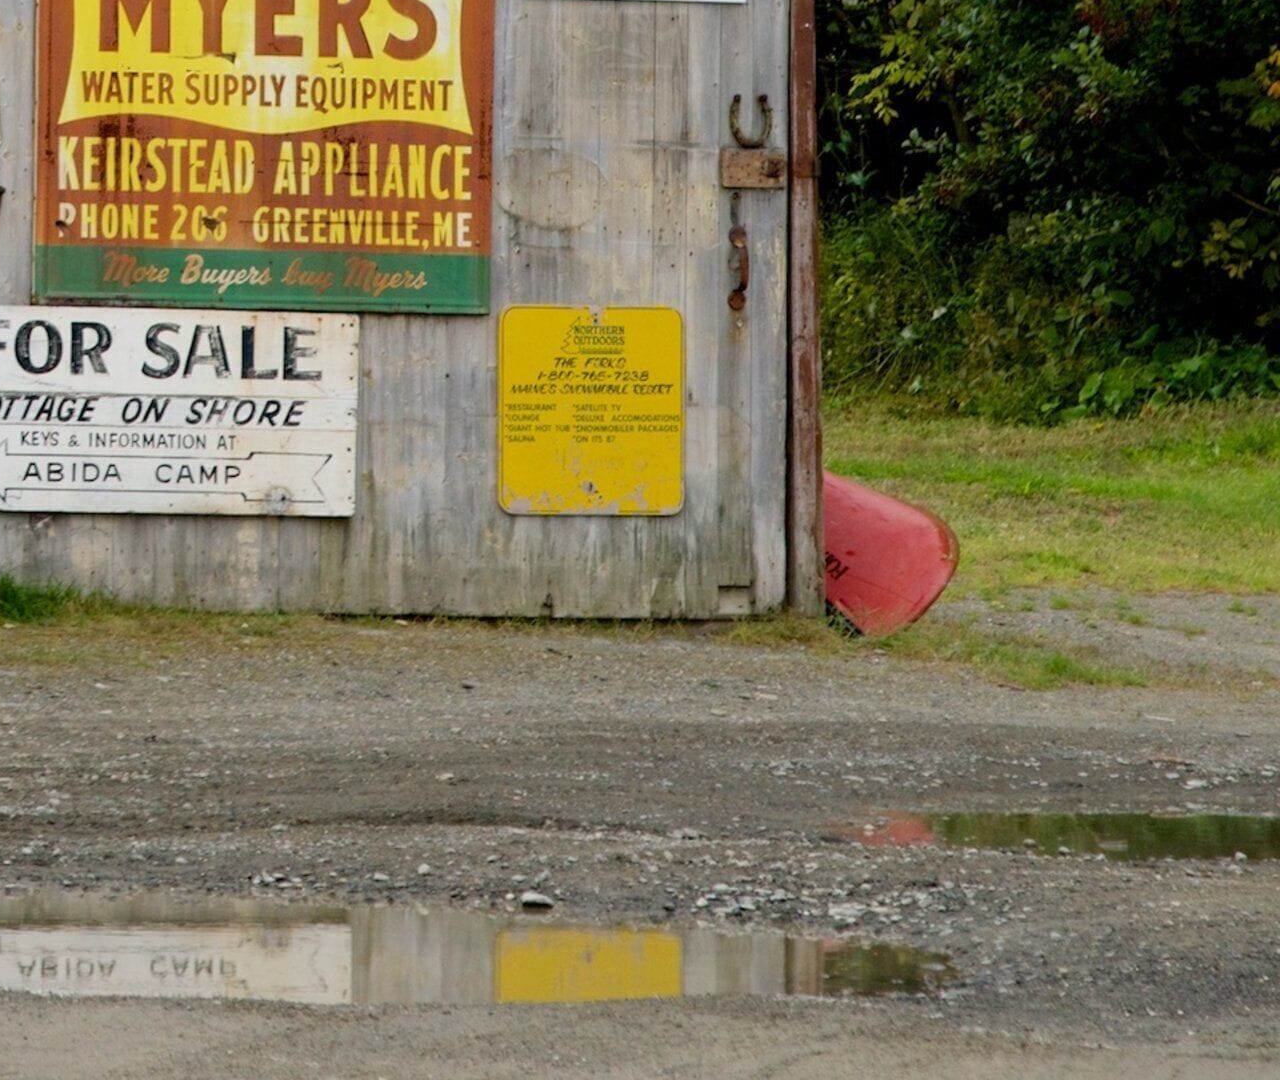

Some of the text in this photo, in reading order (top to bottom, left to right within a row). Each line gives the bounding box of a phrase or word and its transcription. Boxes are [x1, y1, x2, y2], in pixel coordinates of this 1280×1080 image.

[81, 70, 455, 116] WATER SUPPLY EQUIPMENT
[57, 136, 473, 202] KEIRSTEAD APPLIANCE
[58, 203, 160, 241] PHONE
[252, 205, 430, 251] GREENVILLE,
[433, 209, 473, 249] ME
[179, 253, 272, 294] Buyers
[140, 322, 324, 383] SALE
[121, 396, 172, 425] ON
[185, 399, 308, 428] SHORE
[19, 431, 237, 451] KEYS & INFORMATION AT
[22, 461, 242, 484] ABIDA CAMP
